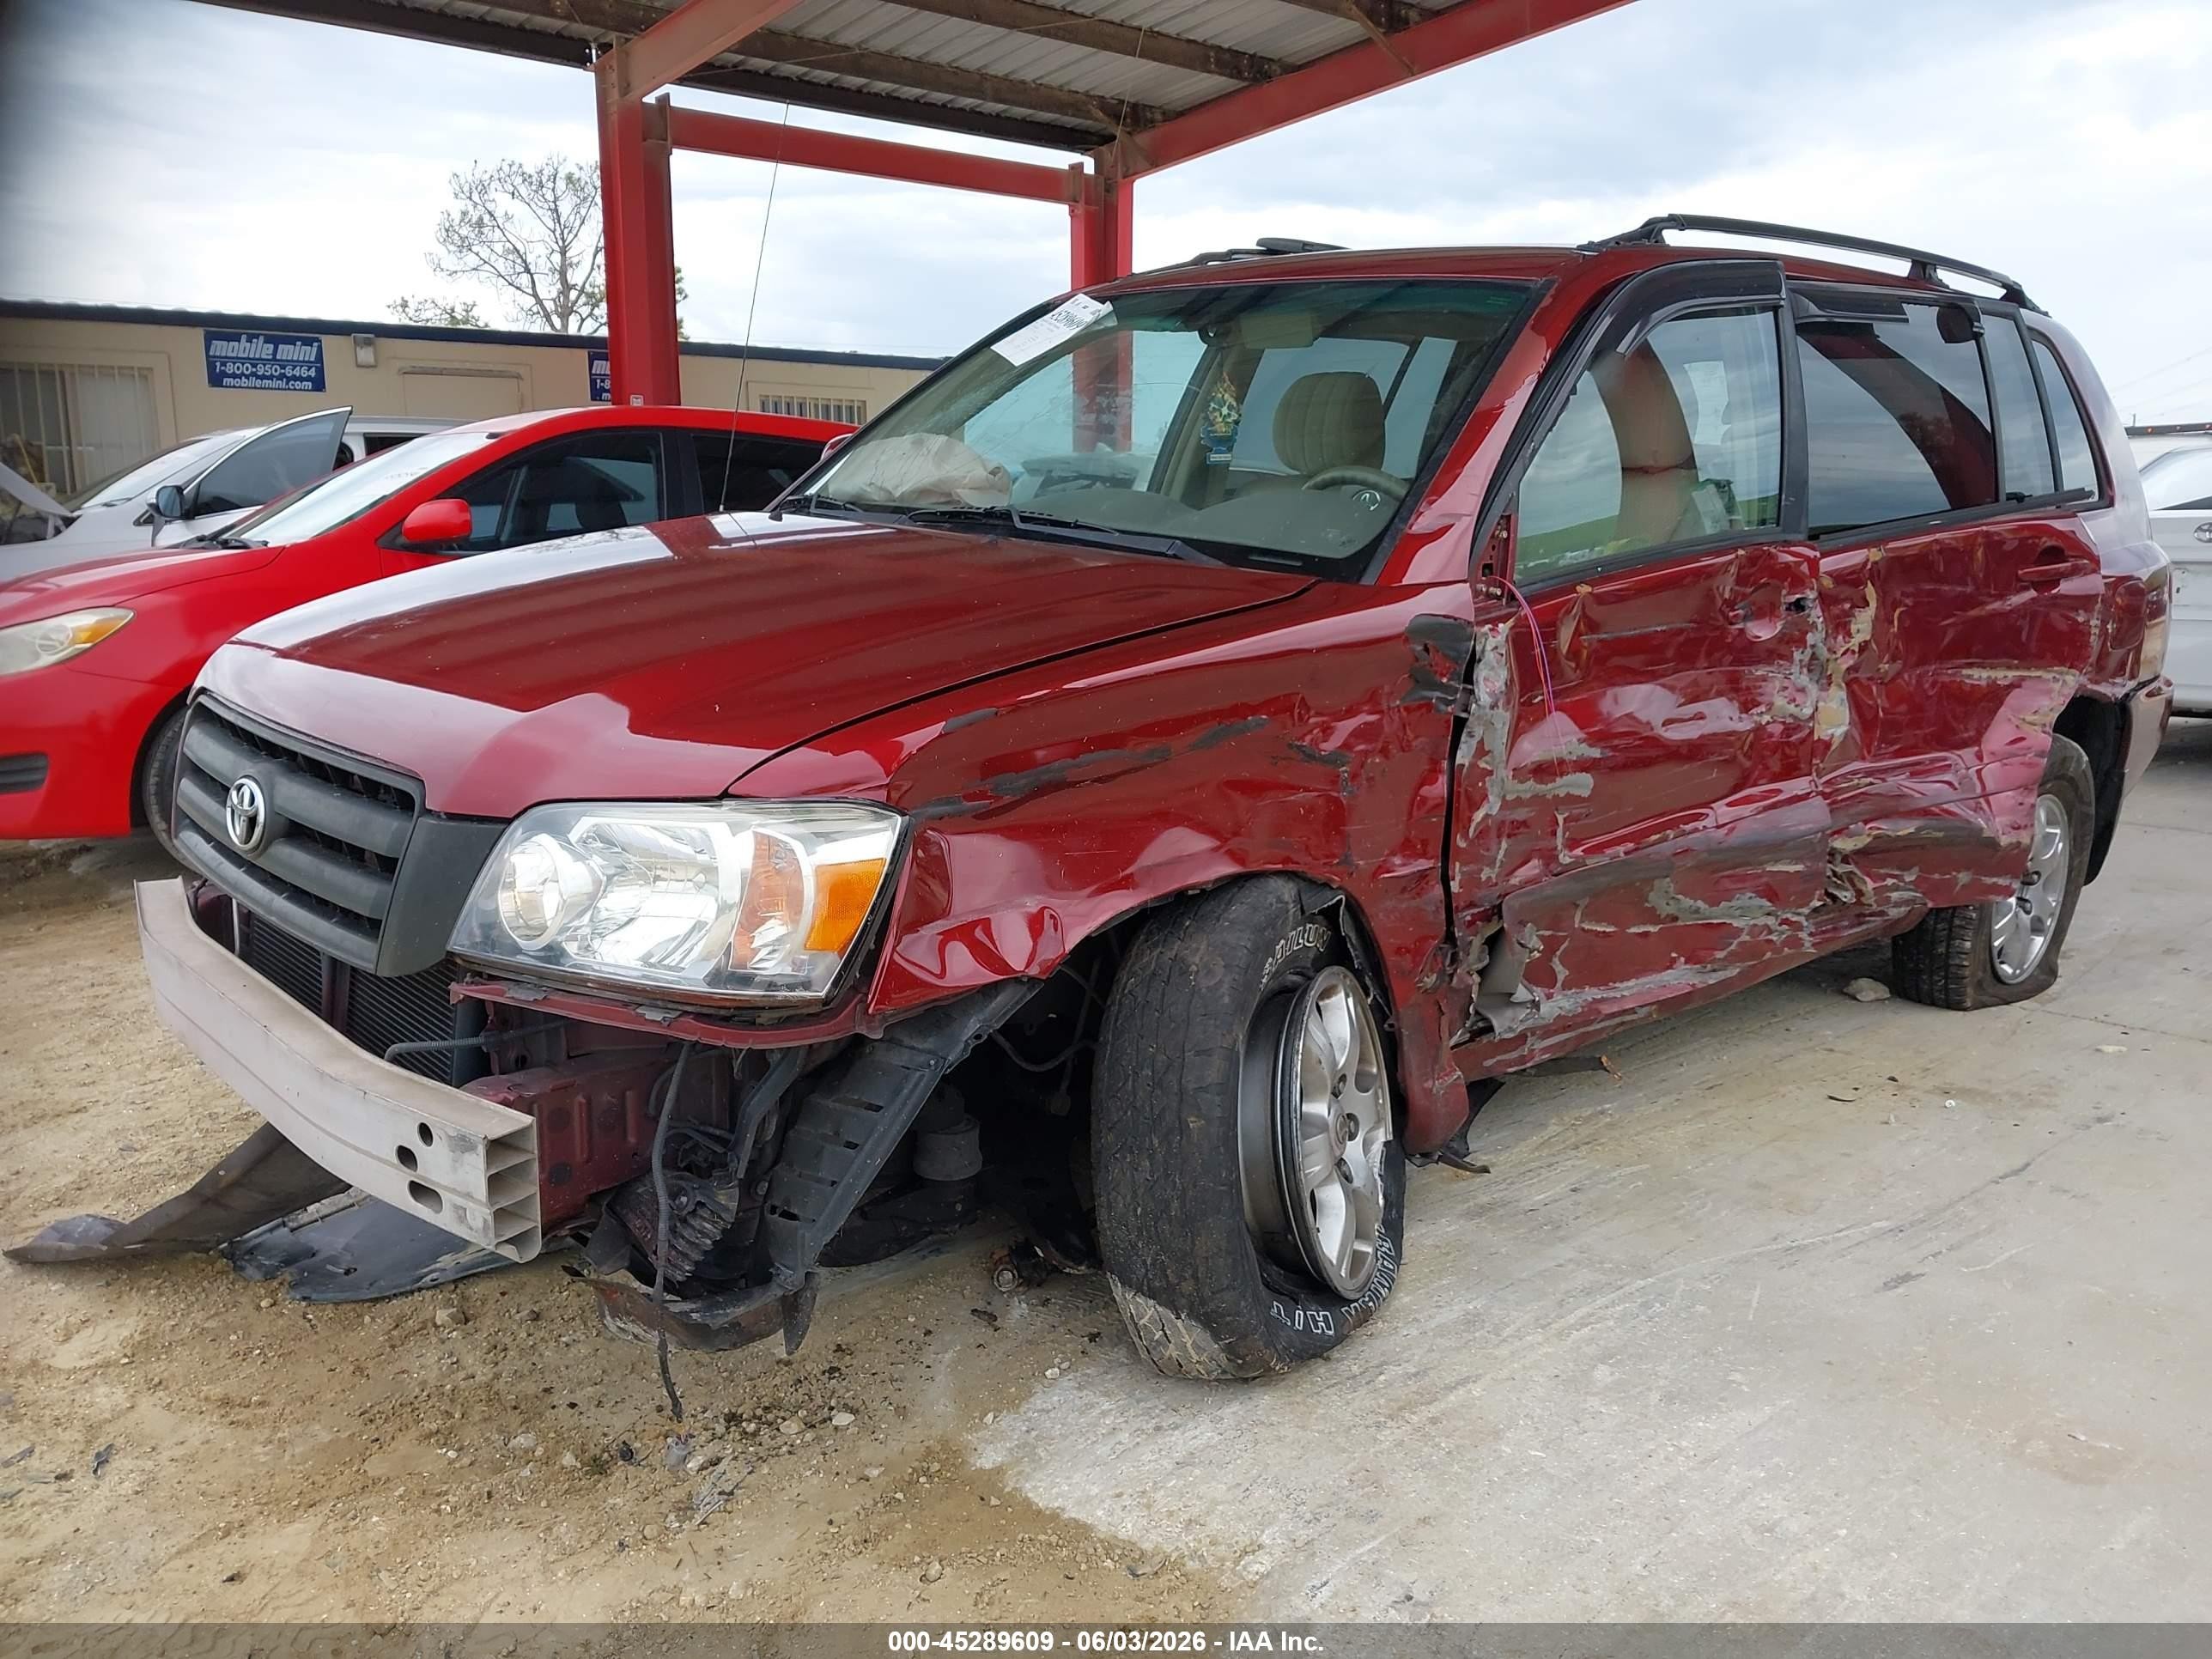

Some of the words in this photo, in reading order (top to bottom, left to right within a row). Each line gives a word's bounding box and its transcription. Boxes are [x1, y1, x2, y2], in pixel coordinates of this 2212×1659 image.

[209, 334, 274, 359] mobile
[276, 341, 319, 362] mini
[215, 362, 316, 378] 1-800-950-6464
[222, 376, 313, 390] mobilemini.com
